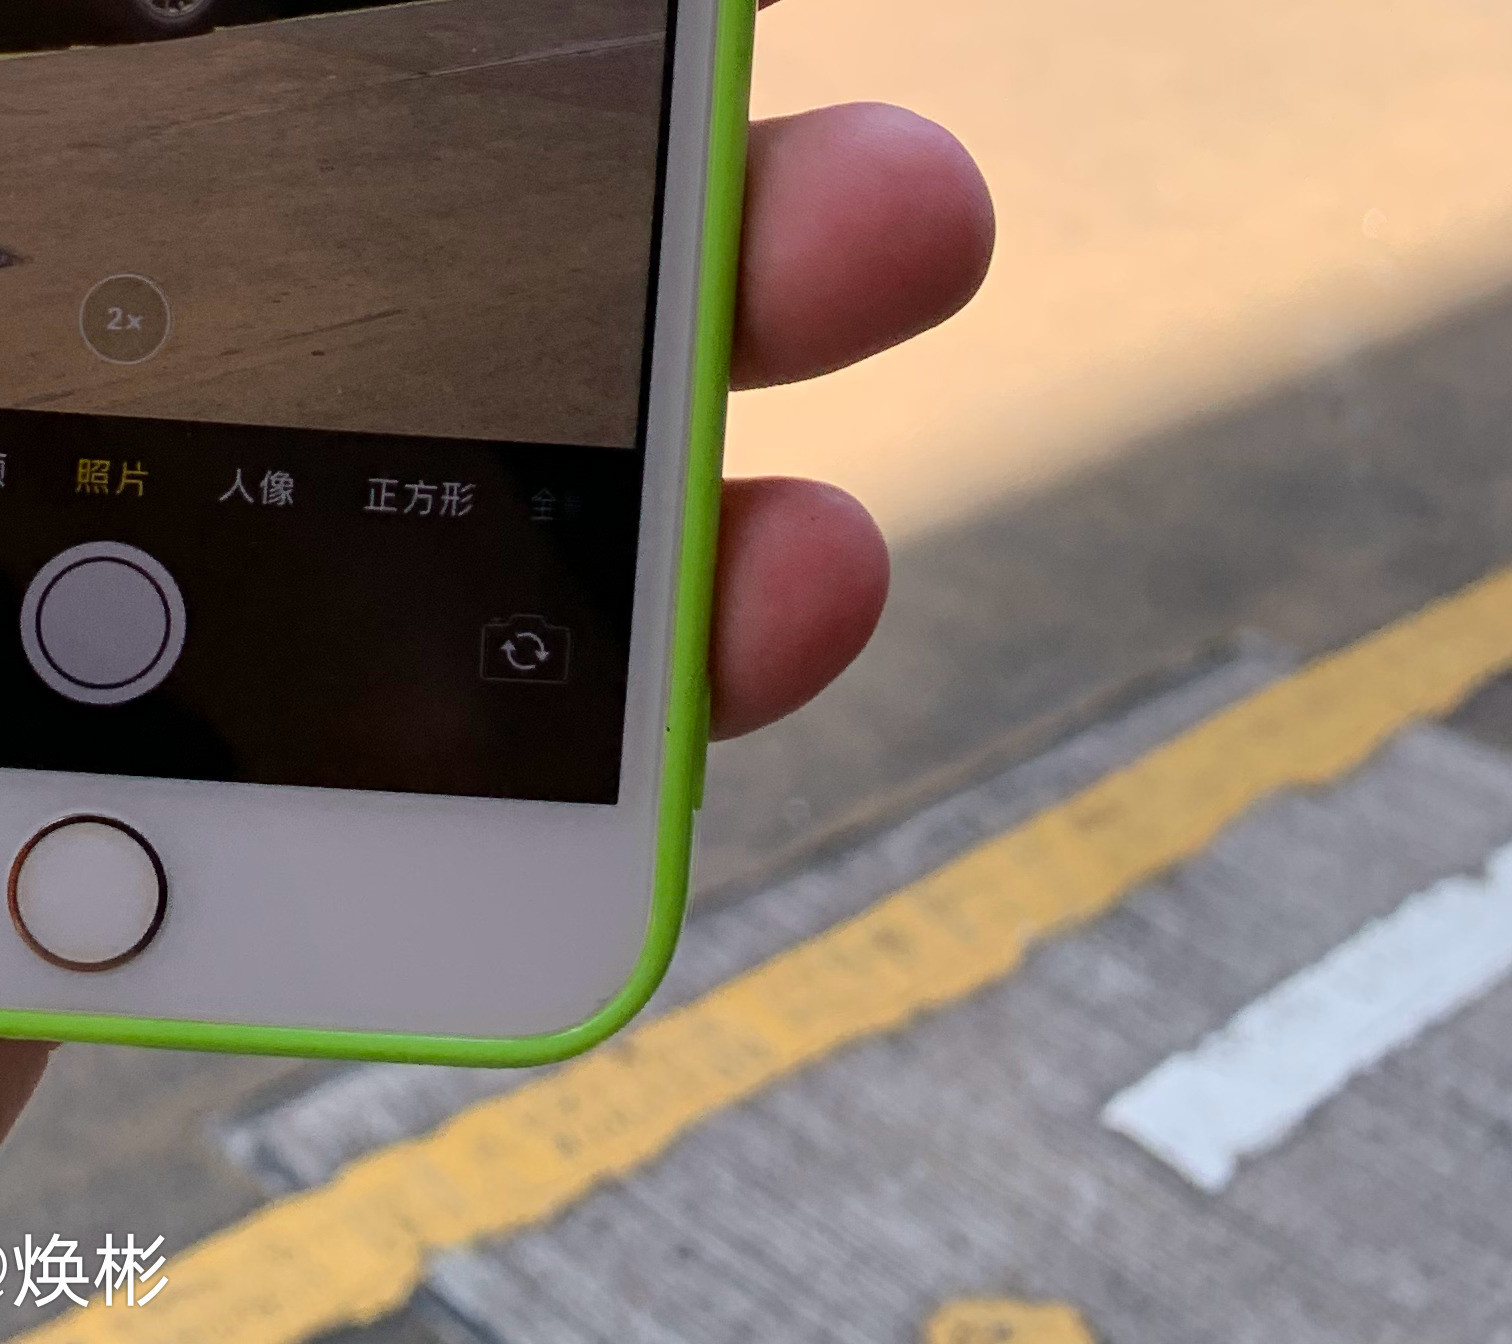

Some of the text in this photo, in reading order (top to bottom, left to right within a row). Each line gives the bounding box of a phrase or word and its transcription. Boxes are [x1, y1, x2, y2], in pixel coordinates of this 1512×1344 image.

[106, 307, 144, 330] 2x
[74, 458, 149, 497] 照片
[218, 468, 295, 506] 人像
[364, 477, 477, 517] 正方形
